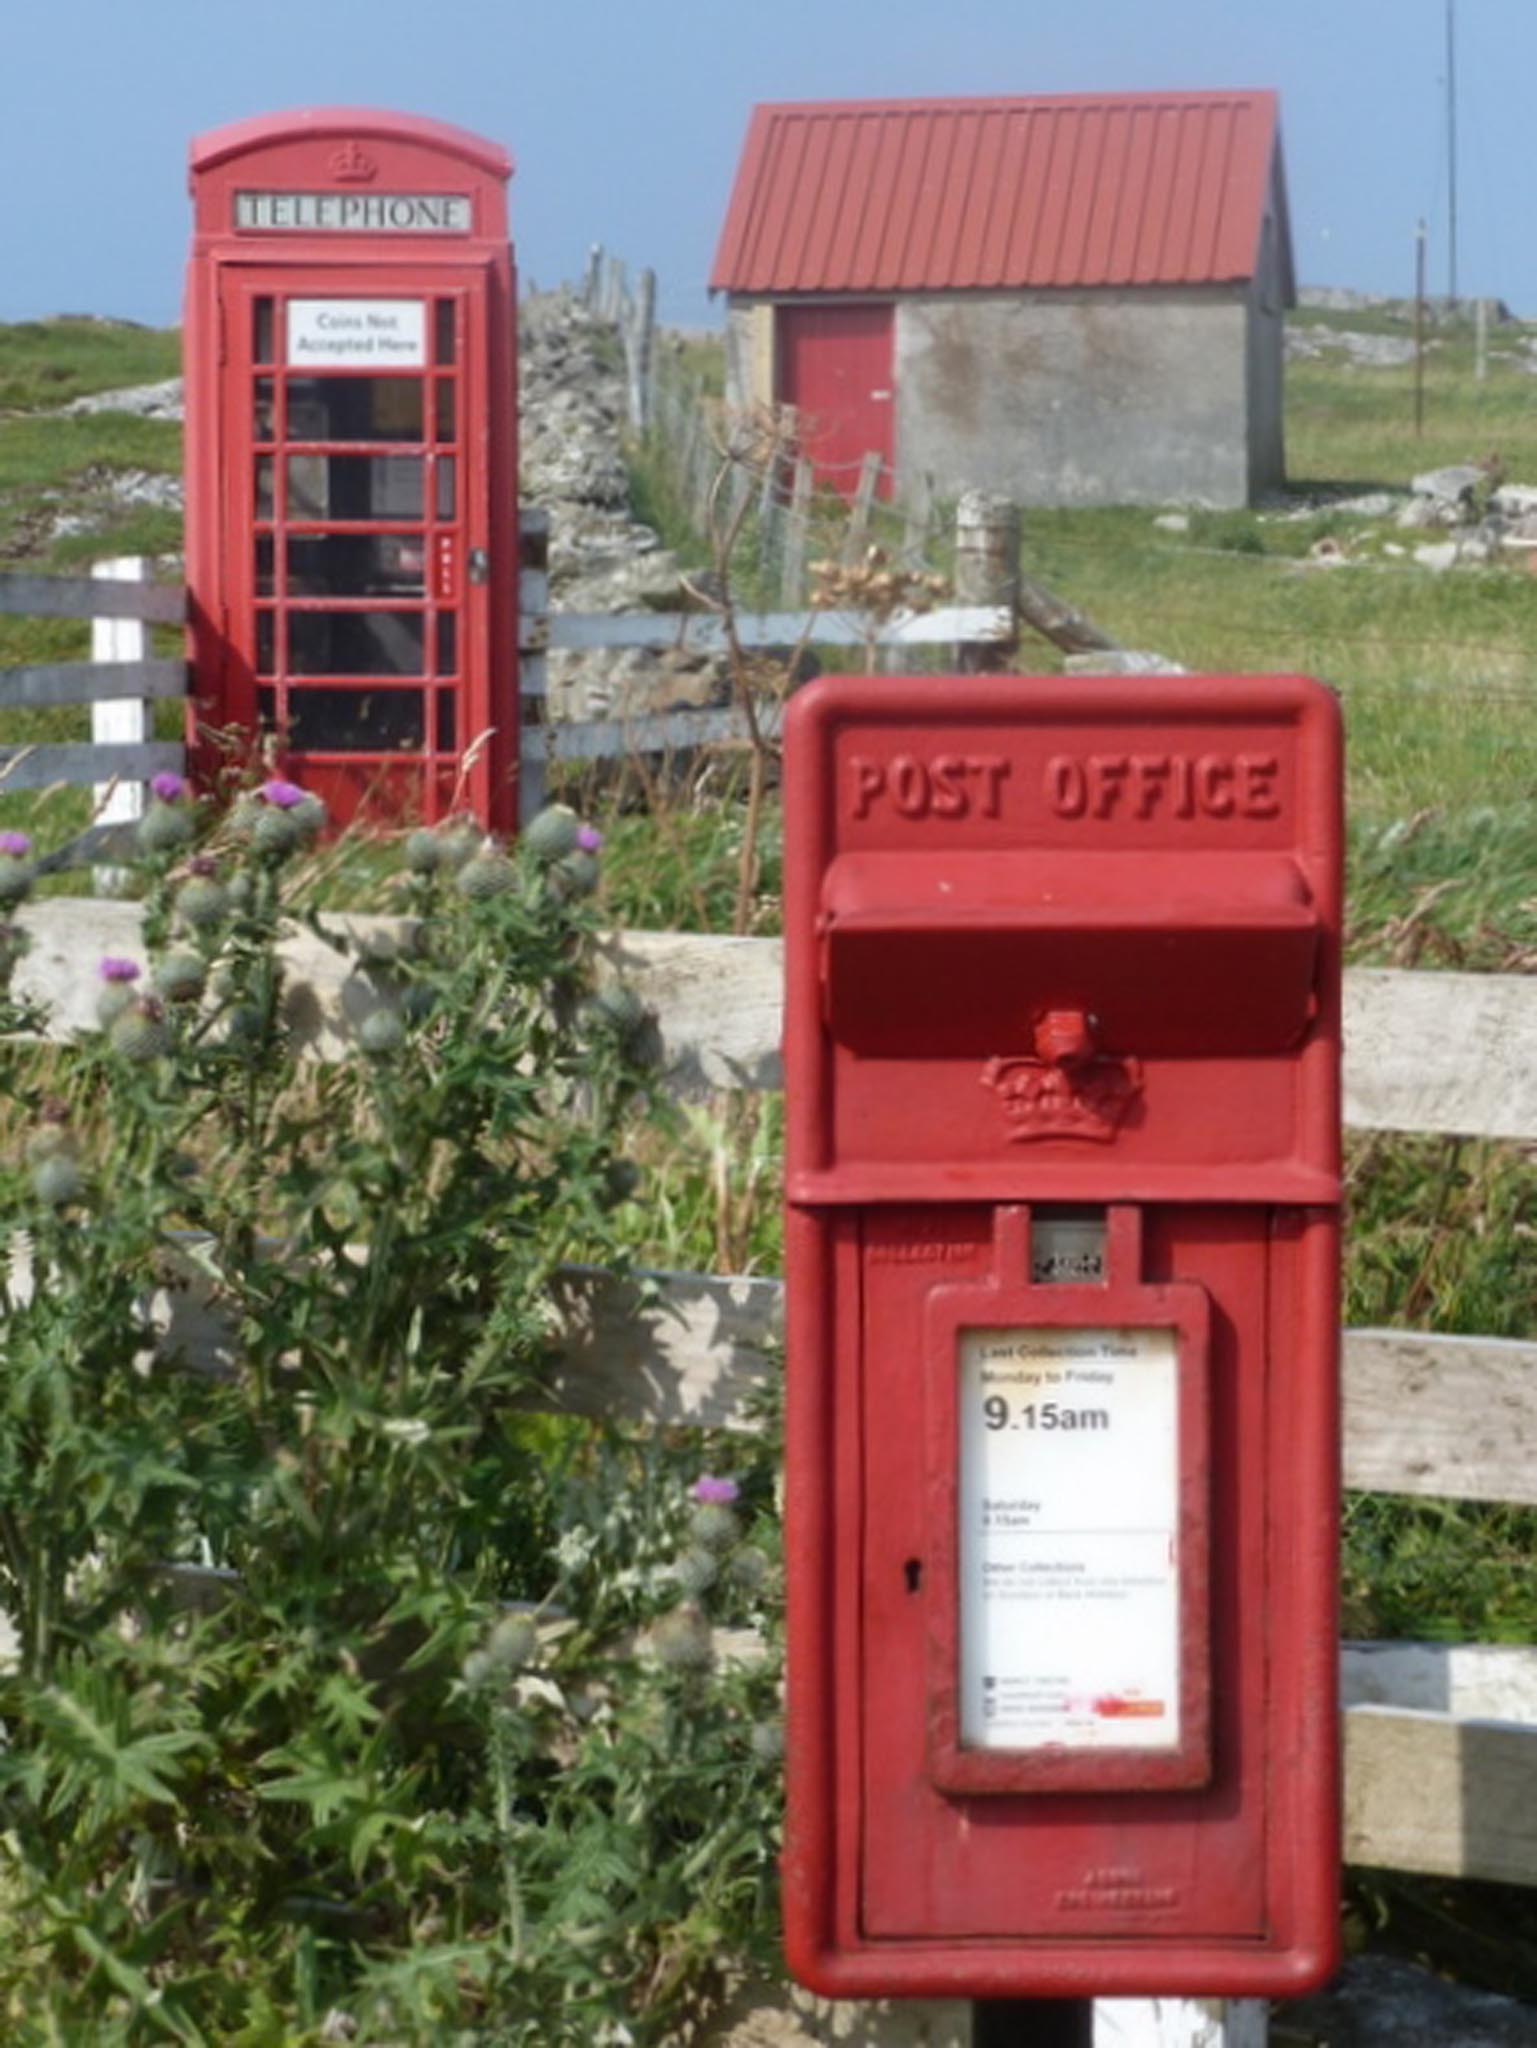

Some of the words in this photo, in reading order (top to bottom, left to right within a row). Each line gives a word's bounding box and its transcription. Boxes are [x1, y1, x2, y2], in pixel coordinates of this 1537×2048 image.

[243, 196, 461, 228] TELEPHONE
[315, 313, 363, 330] Coins
[367, 313, 397, 330] Not
[297, 337, 374, 355] Accepted
[378, 337, 418, 352] Here
[851, 754, 1012, 820] POST
[1046, 754, 1282, 822] OFFICE
[1017, 1345, 1098, 1359] Collection
[979, 1370, 1042, 1386] Monday
[1045, 1370, 1062, 1383] to
[1065, 1370, 1115, 1386] Friday
[983, 1394, 1110, 1431] 9.15am
